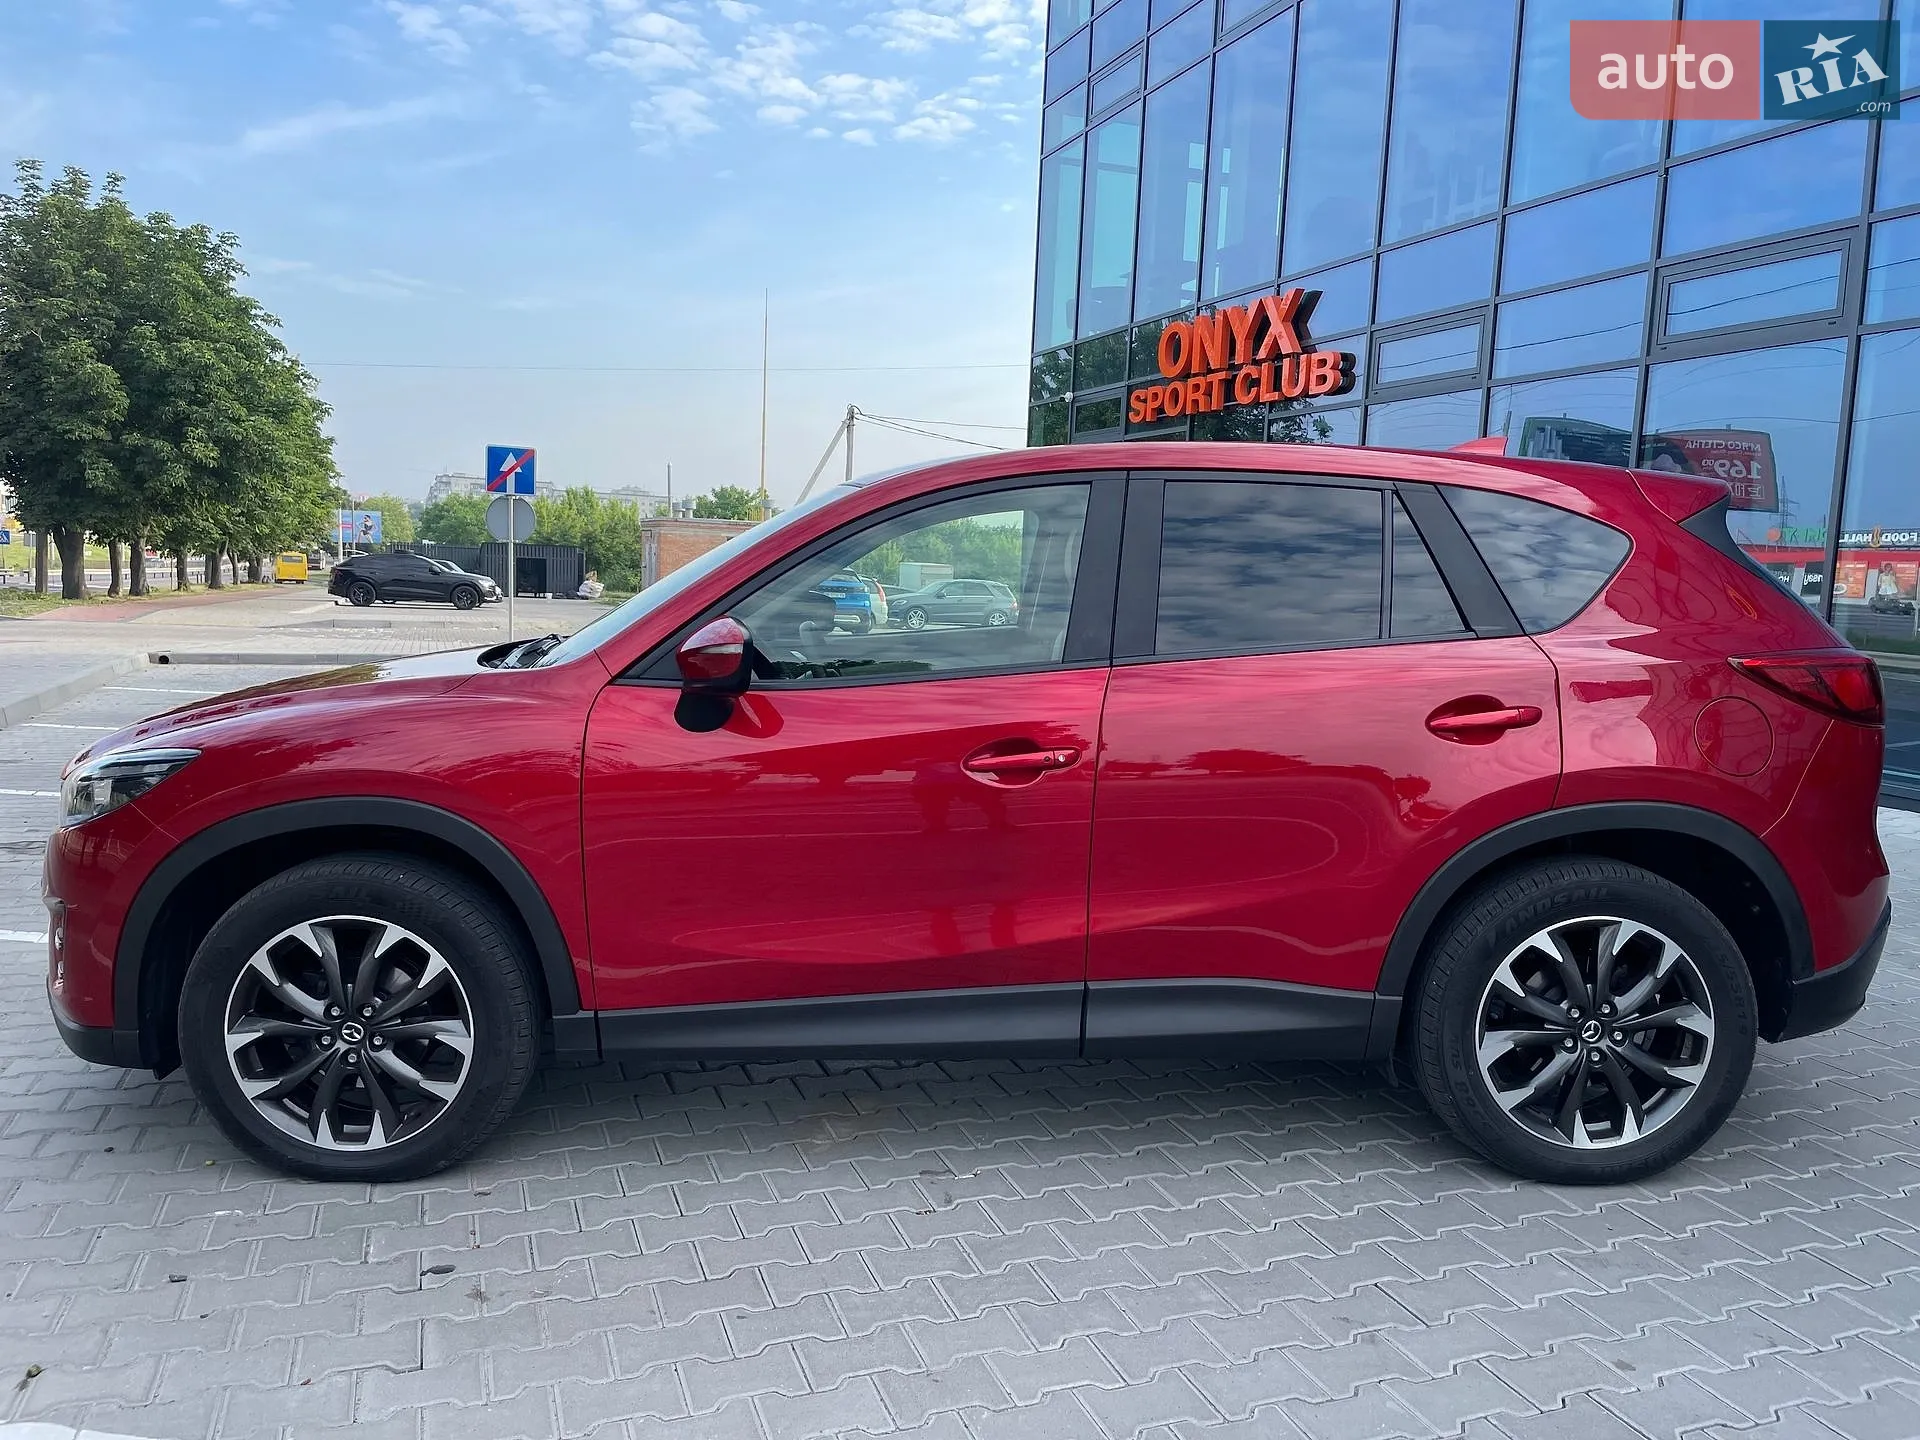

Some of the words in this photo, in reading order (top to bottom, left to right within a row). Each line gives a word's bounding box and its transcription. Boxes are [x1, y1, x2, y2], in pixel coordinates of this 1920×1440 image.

[1157, 287, 1307, 379] ONYX
[1128, 370, 1232, 424] SPORT
[1234, 351, 1343, 406] CLUB
